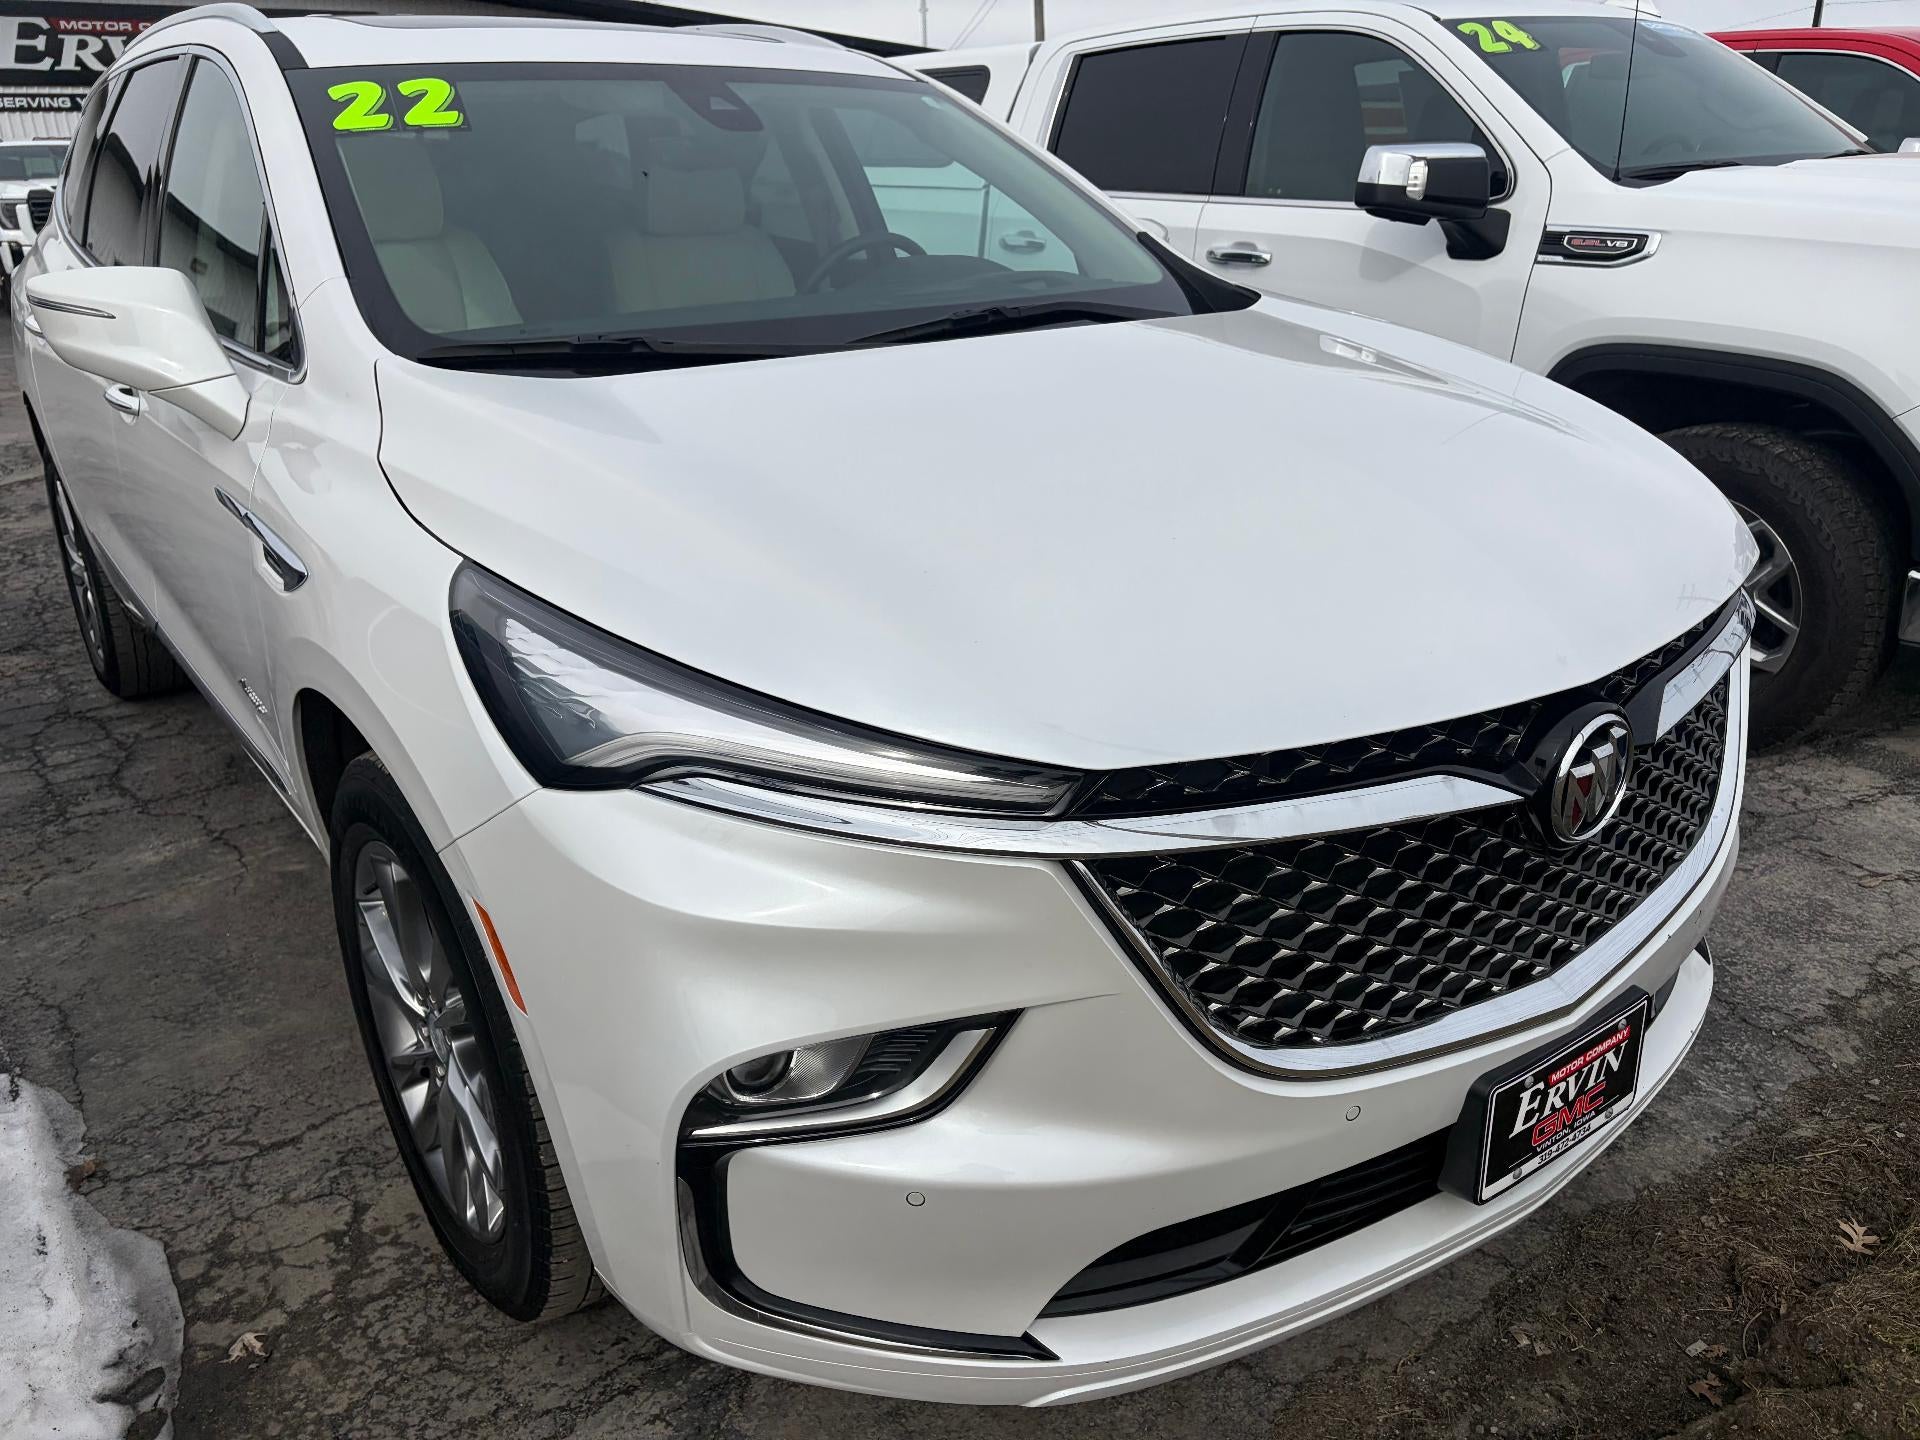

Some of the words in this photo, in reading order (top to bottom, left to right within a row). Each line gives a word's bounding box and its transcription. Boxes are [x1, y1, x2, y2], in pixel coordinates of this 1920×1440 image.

[59, 20, 132, 31] MOTOR
[1457, 20, 1540, 53] 24
[327, 77, 463, 132] 22
[1606, 239, 1628, 248] V8
[1551, 1056, 1584, 1082] MOTOR
[1586, 1028, 1629, 1061] COMPANY
[1509, 1040, 1628, 1139] ERVIN
[1532, 1081, 1606, 1146] GMC
[1537, 1128, 1571, 1152] VINTON,
[1574, 1111, 1596, 1128] IOWA
